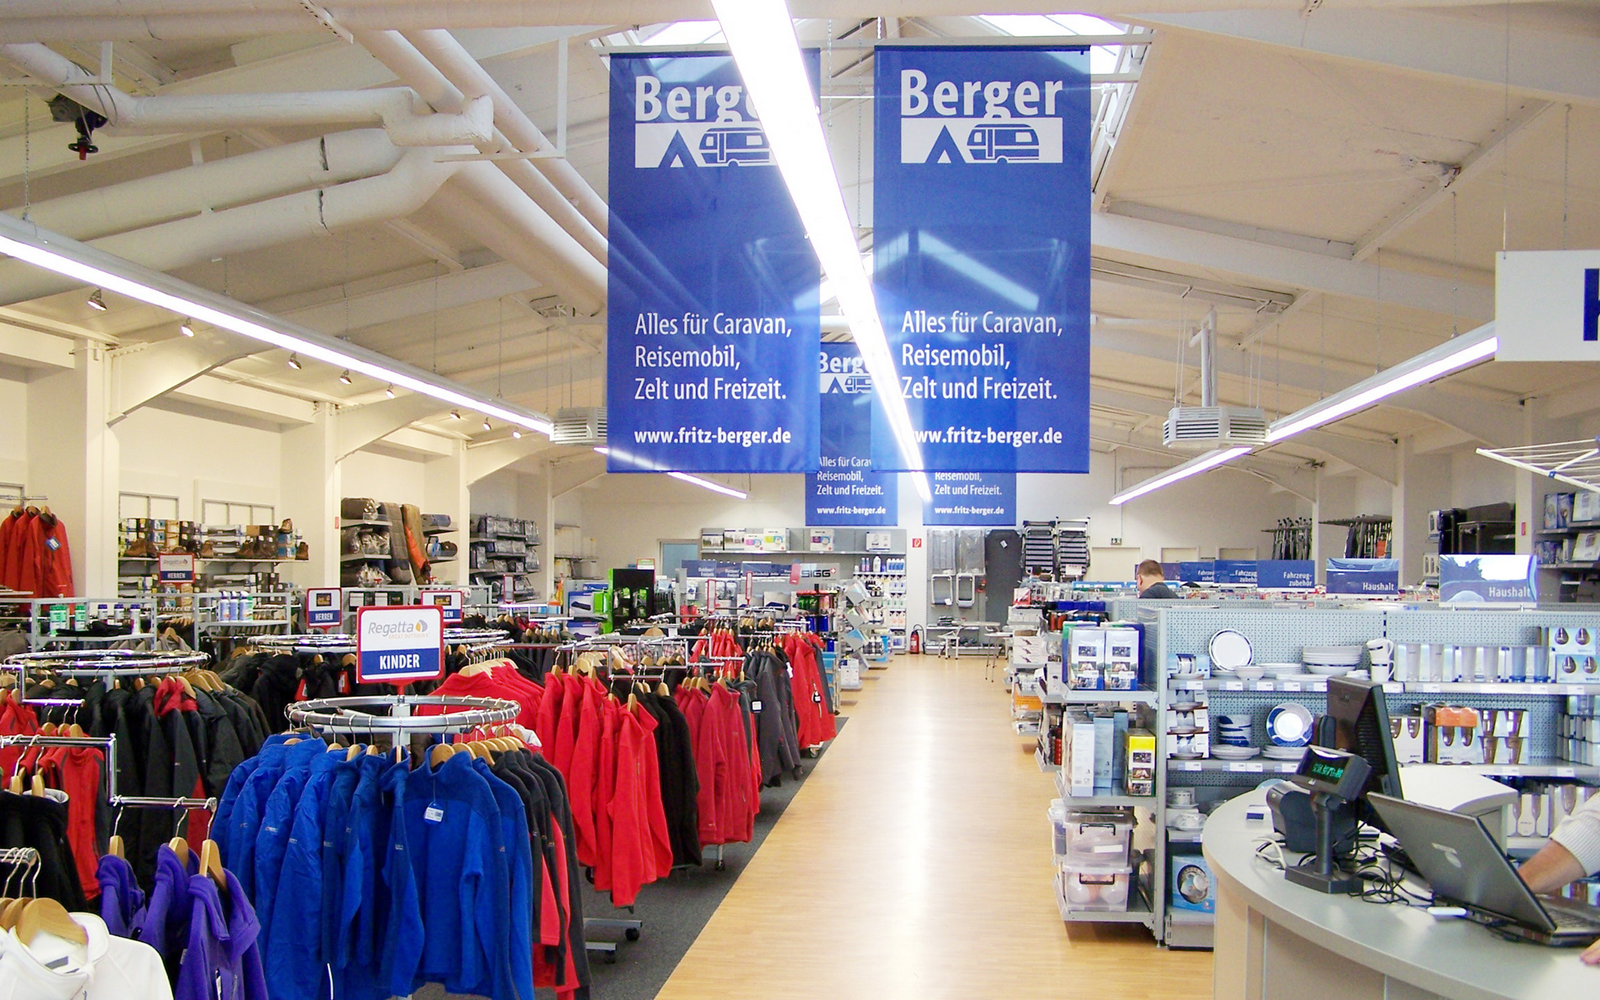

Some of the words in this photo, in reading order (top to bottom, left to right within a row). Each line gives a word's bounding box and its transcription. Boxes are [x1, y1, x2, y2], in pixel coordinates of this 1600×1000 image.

[634, 74, 759, 122] Berg
[900, 68, 1064, 119] Berger
[634, 312, 679, 335] Alles
[682, 312, 709, 335] für
[713, 312, 792, 338] Caravan,
[901, 310, 947, 333] Alles
[950, 310, 979, 333] für
[982, 311, 1063, 337] Caravan,
[634, 344, 741, 371] Reisemobil,
[902, 343, 1011, 370] Reisemobil,
[820, 352, 870, 375] Berg
[634, 377, 670, 400] Zelt
[674, 377, 709, 400] und
[713, 377, 787, 400] Freizeit.
[901, 376, 937, 400] Zelt
[942, 376, 978, 400] und
[983, 376, 1058, 400] Freizeit.
[634, 426, 792, 448] www.fritz-berger.de
[912, 426, 1063, 448] ww.fritz-berger.de
[838, 456, 850, 467] für
[851, 456, 871, 467] Carav
[817, 471, 865, 483] Reisemobil,
[935, 472, 982, 482] Reisemobil,
[817, 484, 833, 495] Zelt
[834, 484, 850, 495] und
[852, 484, 885, 495] Freizeit.
[935, 484, 951, 495] Zelt
[952, 484, 968, 495] und
[970, 484, 1003, 495] Freizeit.
[817, 505, 887, 515] www.fritz-berger.de
[935, 506, 1005, 515] www.fritz-berger.de
[801, 569, 831, 578] SIGG
[1283, 571, 1313, 580] Fahrzeug-
[1288, 579, 1313, 587] zubehör
[1362, 581, 1395, 591] Haushalt
[1489, 586, 1531, 598] Haushalt
[315, 612, 334, 621] HERREN
[443, 610, 454, 618] REN
[368, 621, 414, 637] Regatta
[379, 653, 420, 670] KINDER
